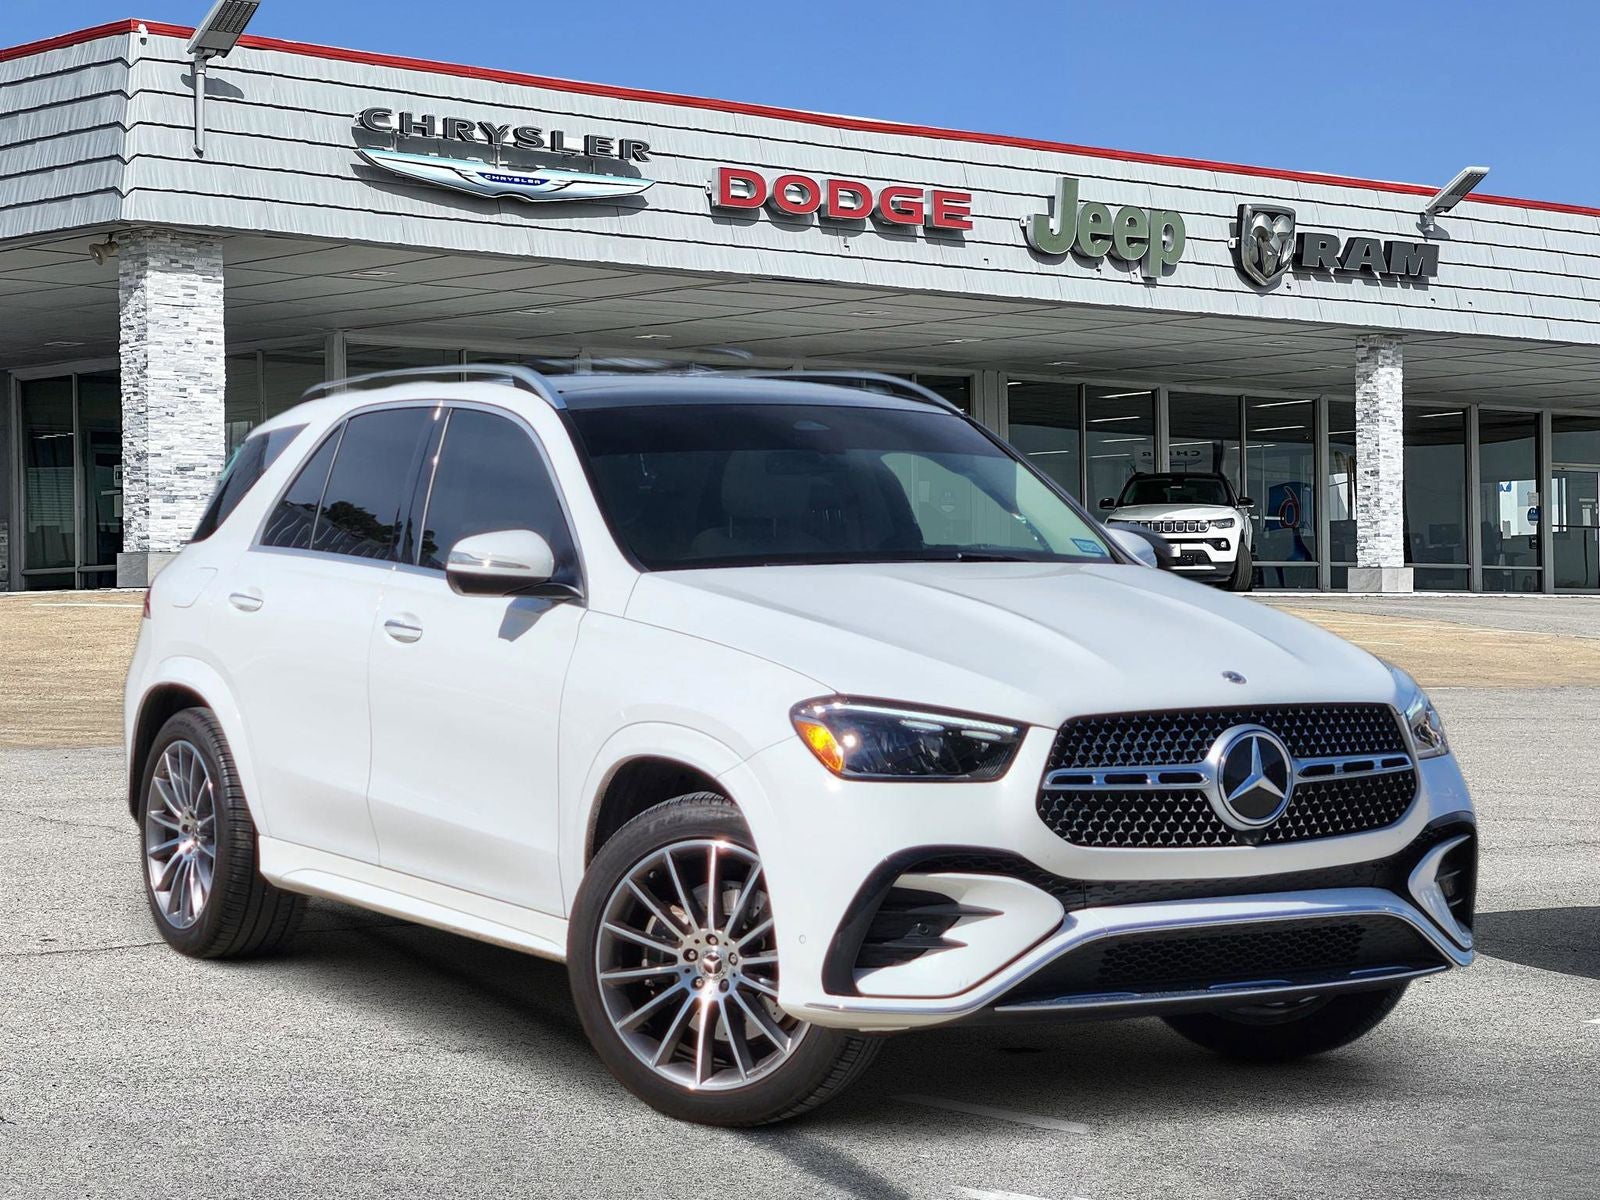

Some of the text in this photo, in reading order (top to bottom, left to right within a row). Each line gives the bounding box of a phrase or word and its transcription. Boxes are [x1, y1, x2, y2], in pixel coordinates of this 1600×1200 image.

[358, 106, 652, 163] CHRYSLER
[484, 174, 541, 185] CHRYSLER
[711, 166, 974, 231] DODGE
[1027, 177, 1186, 278] Jeep
[1297, 231, 1441, 278] RAM
